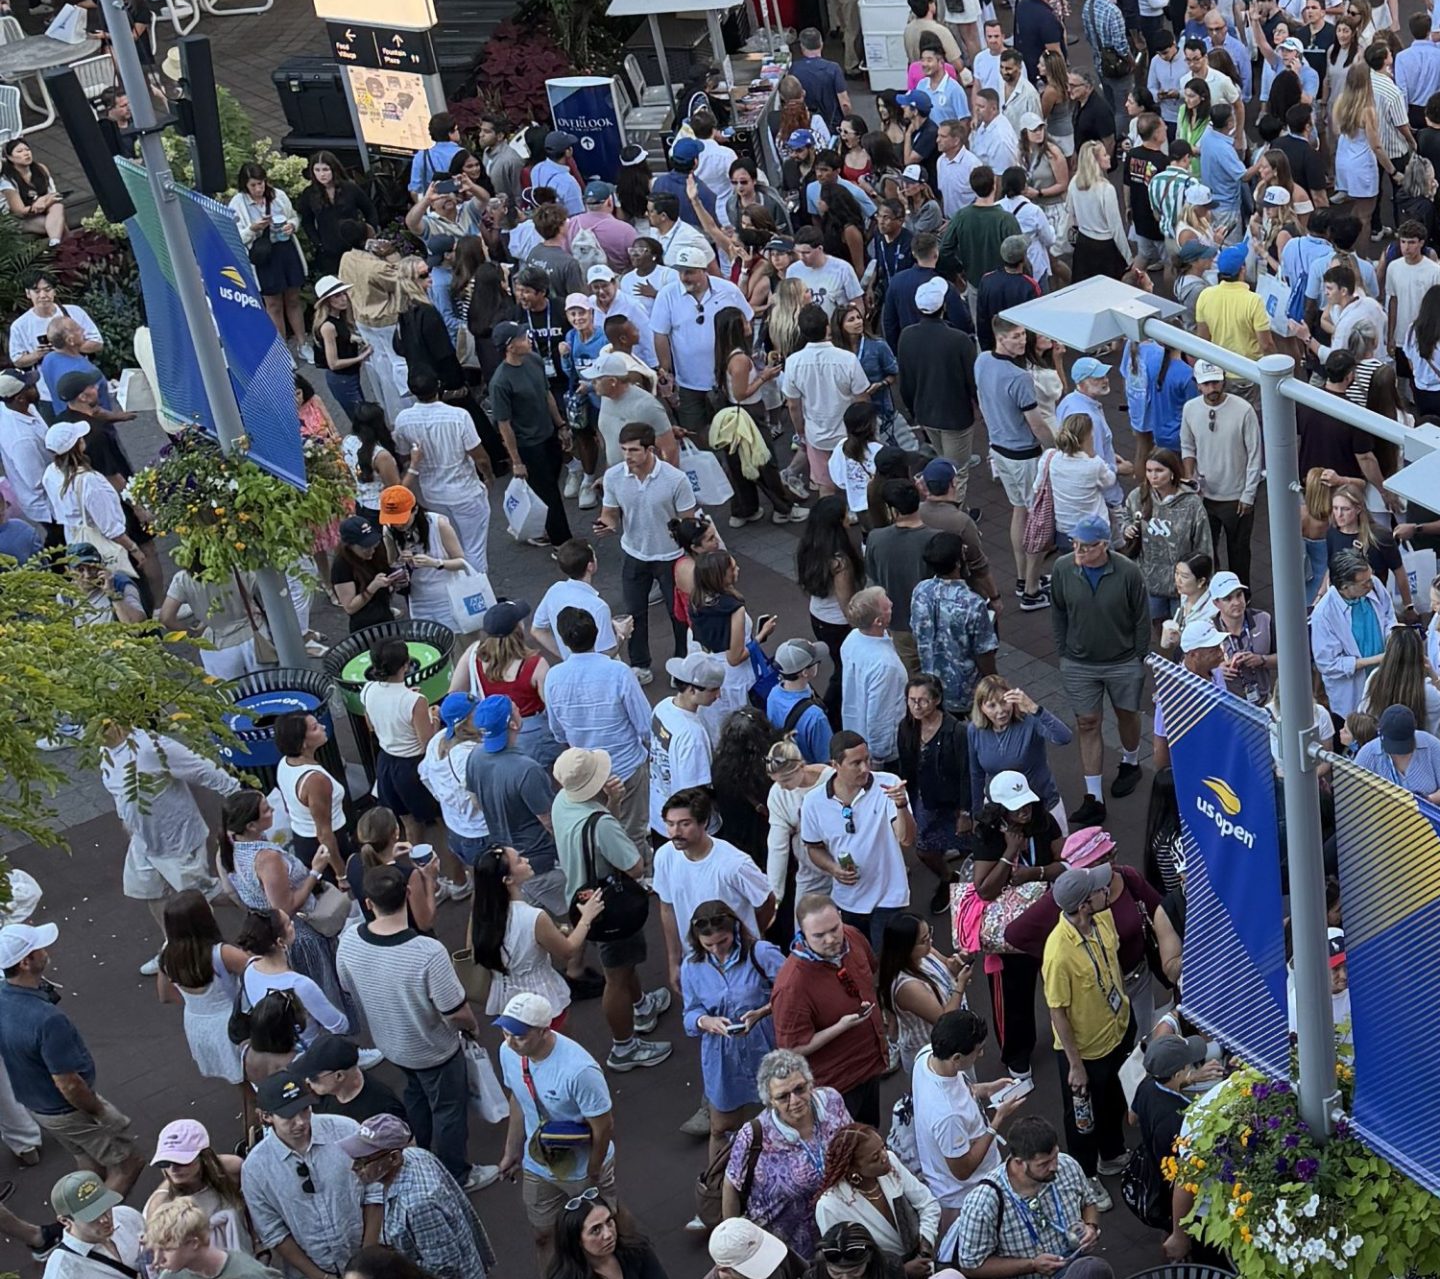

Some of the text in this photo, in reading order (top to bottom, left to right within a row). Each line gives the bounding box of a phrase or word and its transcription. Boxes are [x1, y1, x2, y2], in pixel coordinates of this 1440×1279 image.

[557, 117, 614, 127] OVERLOOK
[219, 286, 233, 300] us
[1196, 795, 1254, 849] us open
